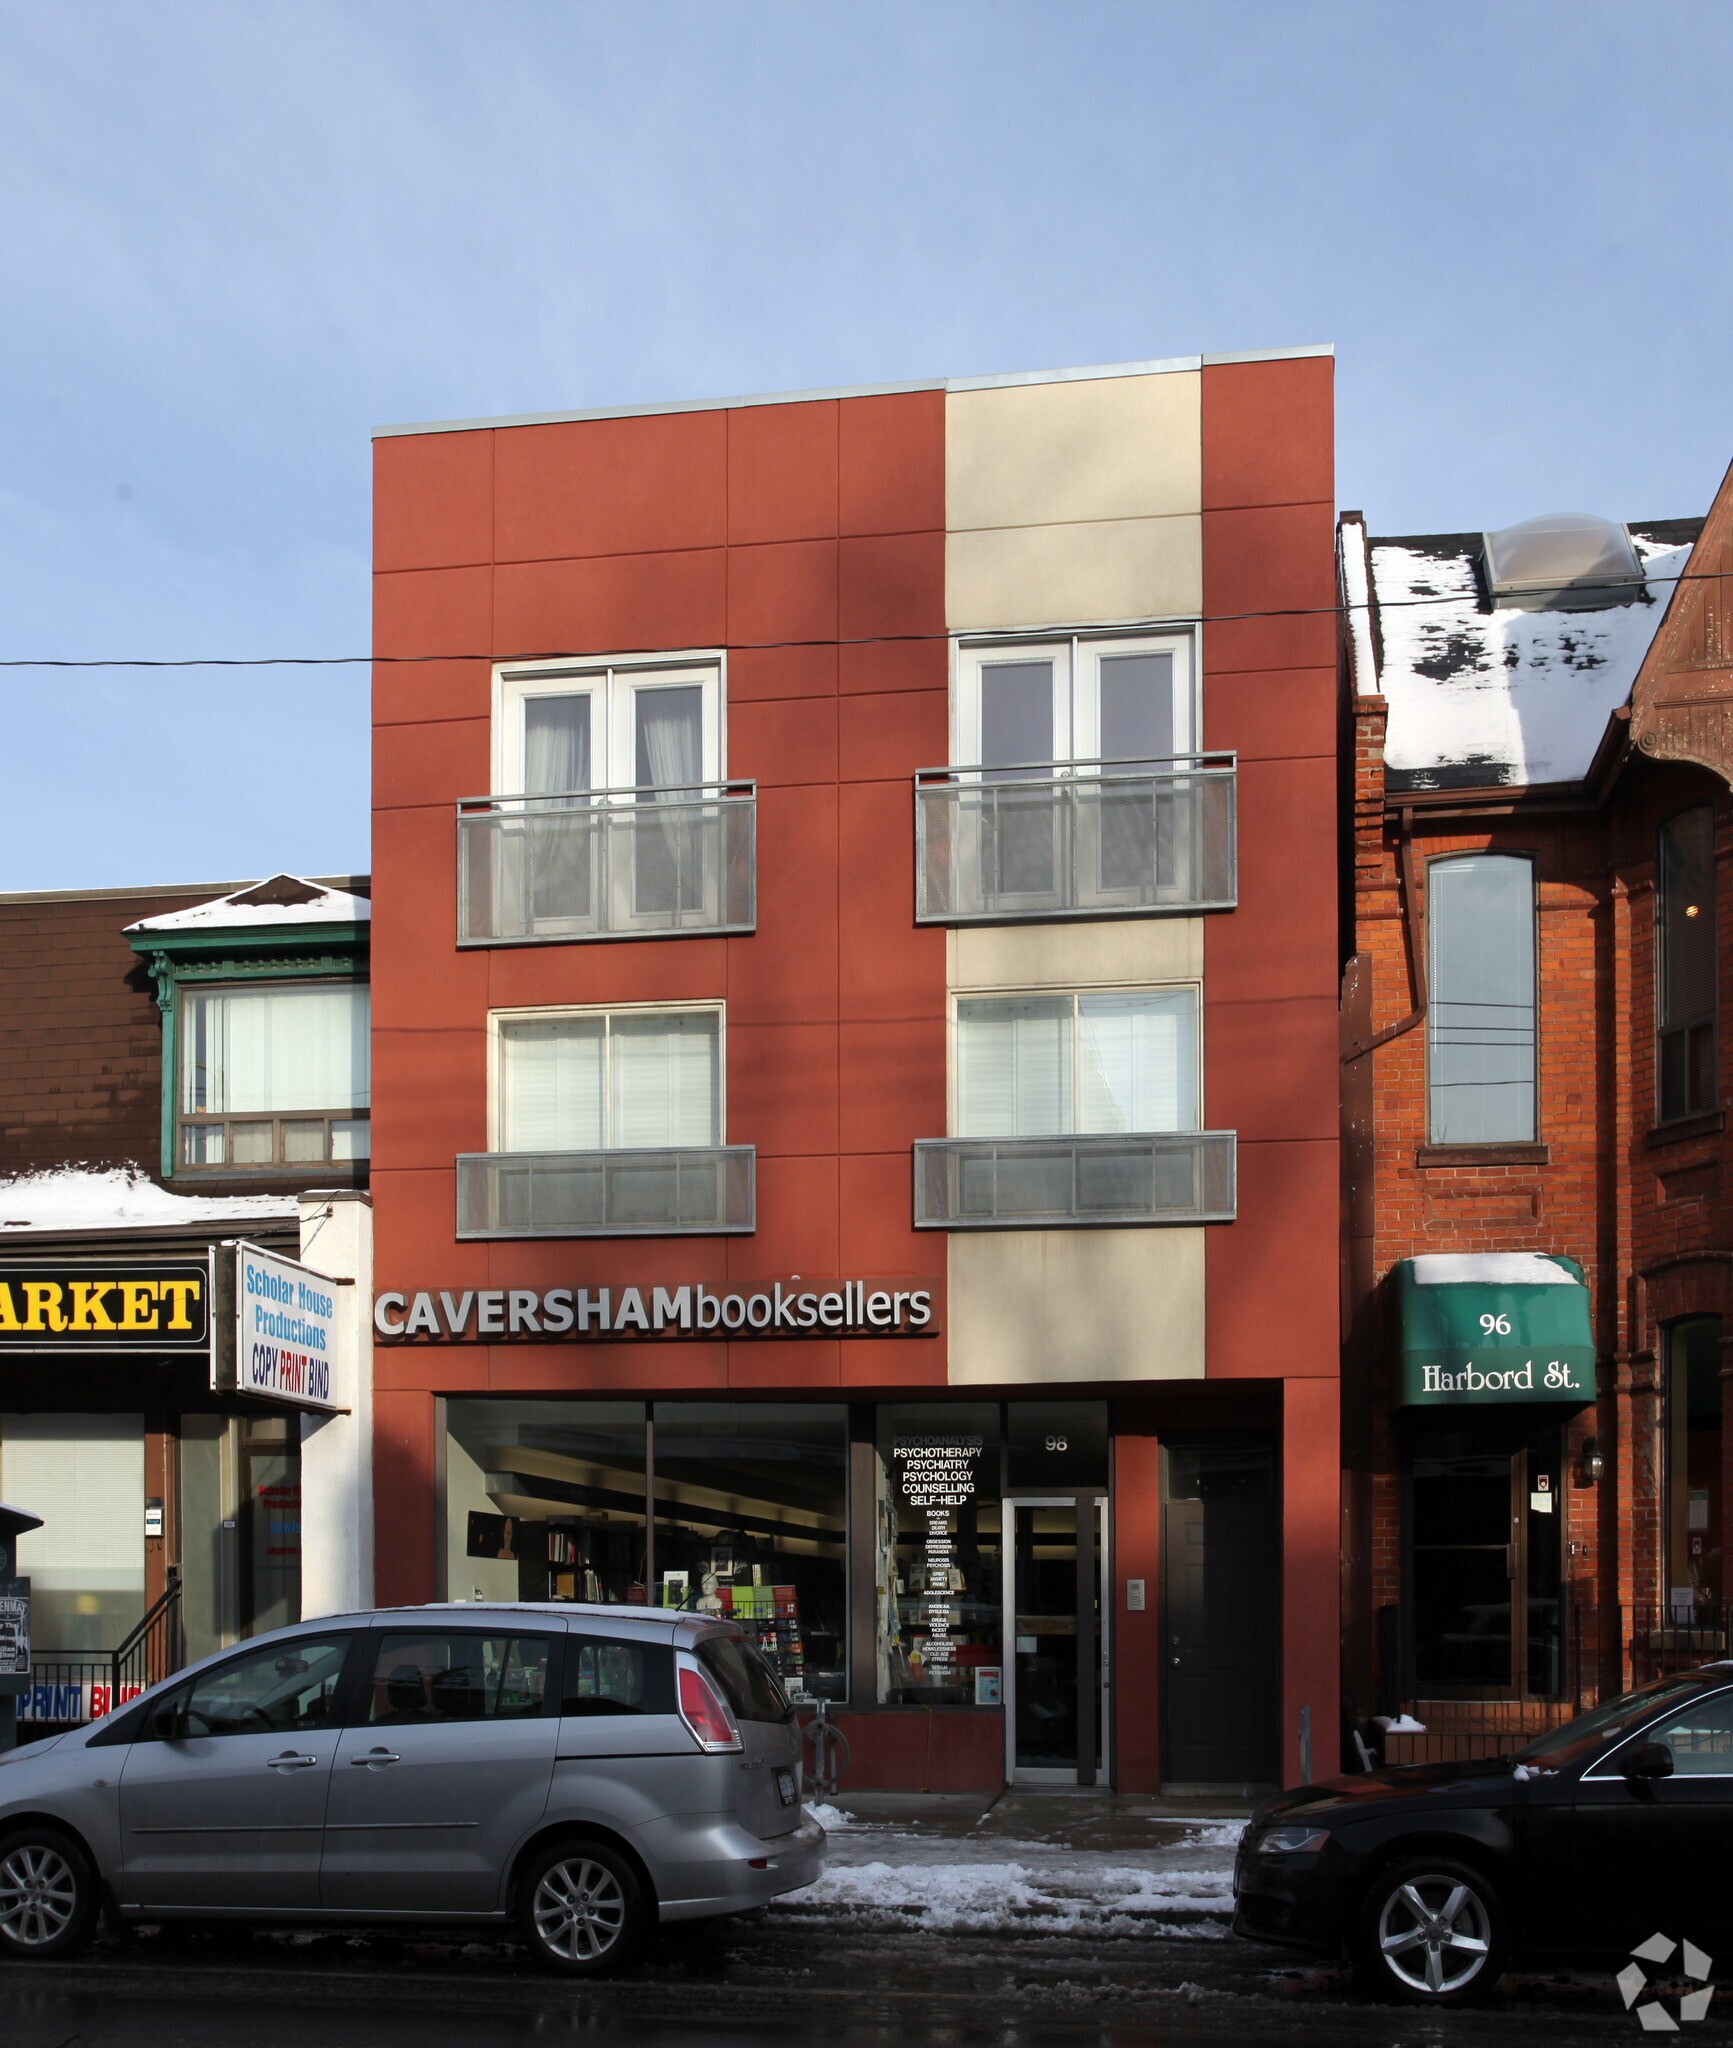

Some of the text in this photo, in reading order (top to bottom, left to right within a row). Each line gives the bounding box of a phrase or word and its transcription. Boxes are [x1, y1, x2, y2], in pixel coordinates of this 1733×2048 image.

[247, 1264, 333, 1319] Scholar House
[255, 1303, 326, 1351] Productions
[1479, 1313, 1512, 1336] 96
[252, 1342, 330, 1400] COPY PRINT BIND
[1422, 1360, 1581, 1392] Harbord St.
[893, 1435, 983, 1446] PSYCHOANALYSIS
[1045, 1435, 1068, 1451] 98
[893, 1447, 982, 1458] PSYCHOTHERAPY
[906, 1459, 970, 1470] PSYCHIATRY
[902, 1471, 973, 1482] PSYCHOLOGY
[902, 1483, 975, 1494] COUNSELLING
[910, 1495, 967, 1506] SELF-HELP
